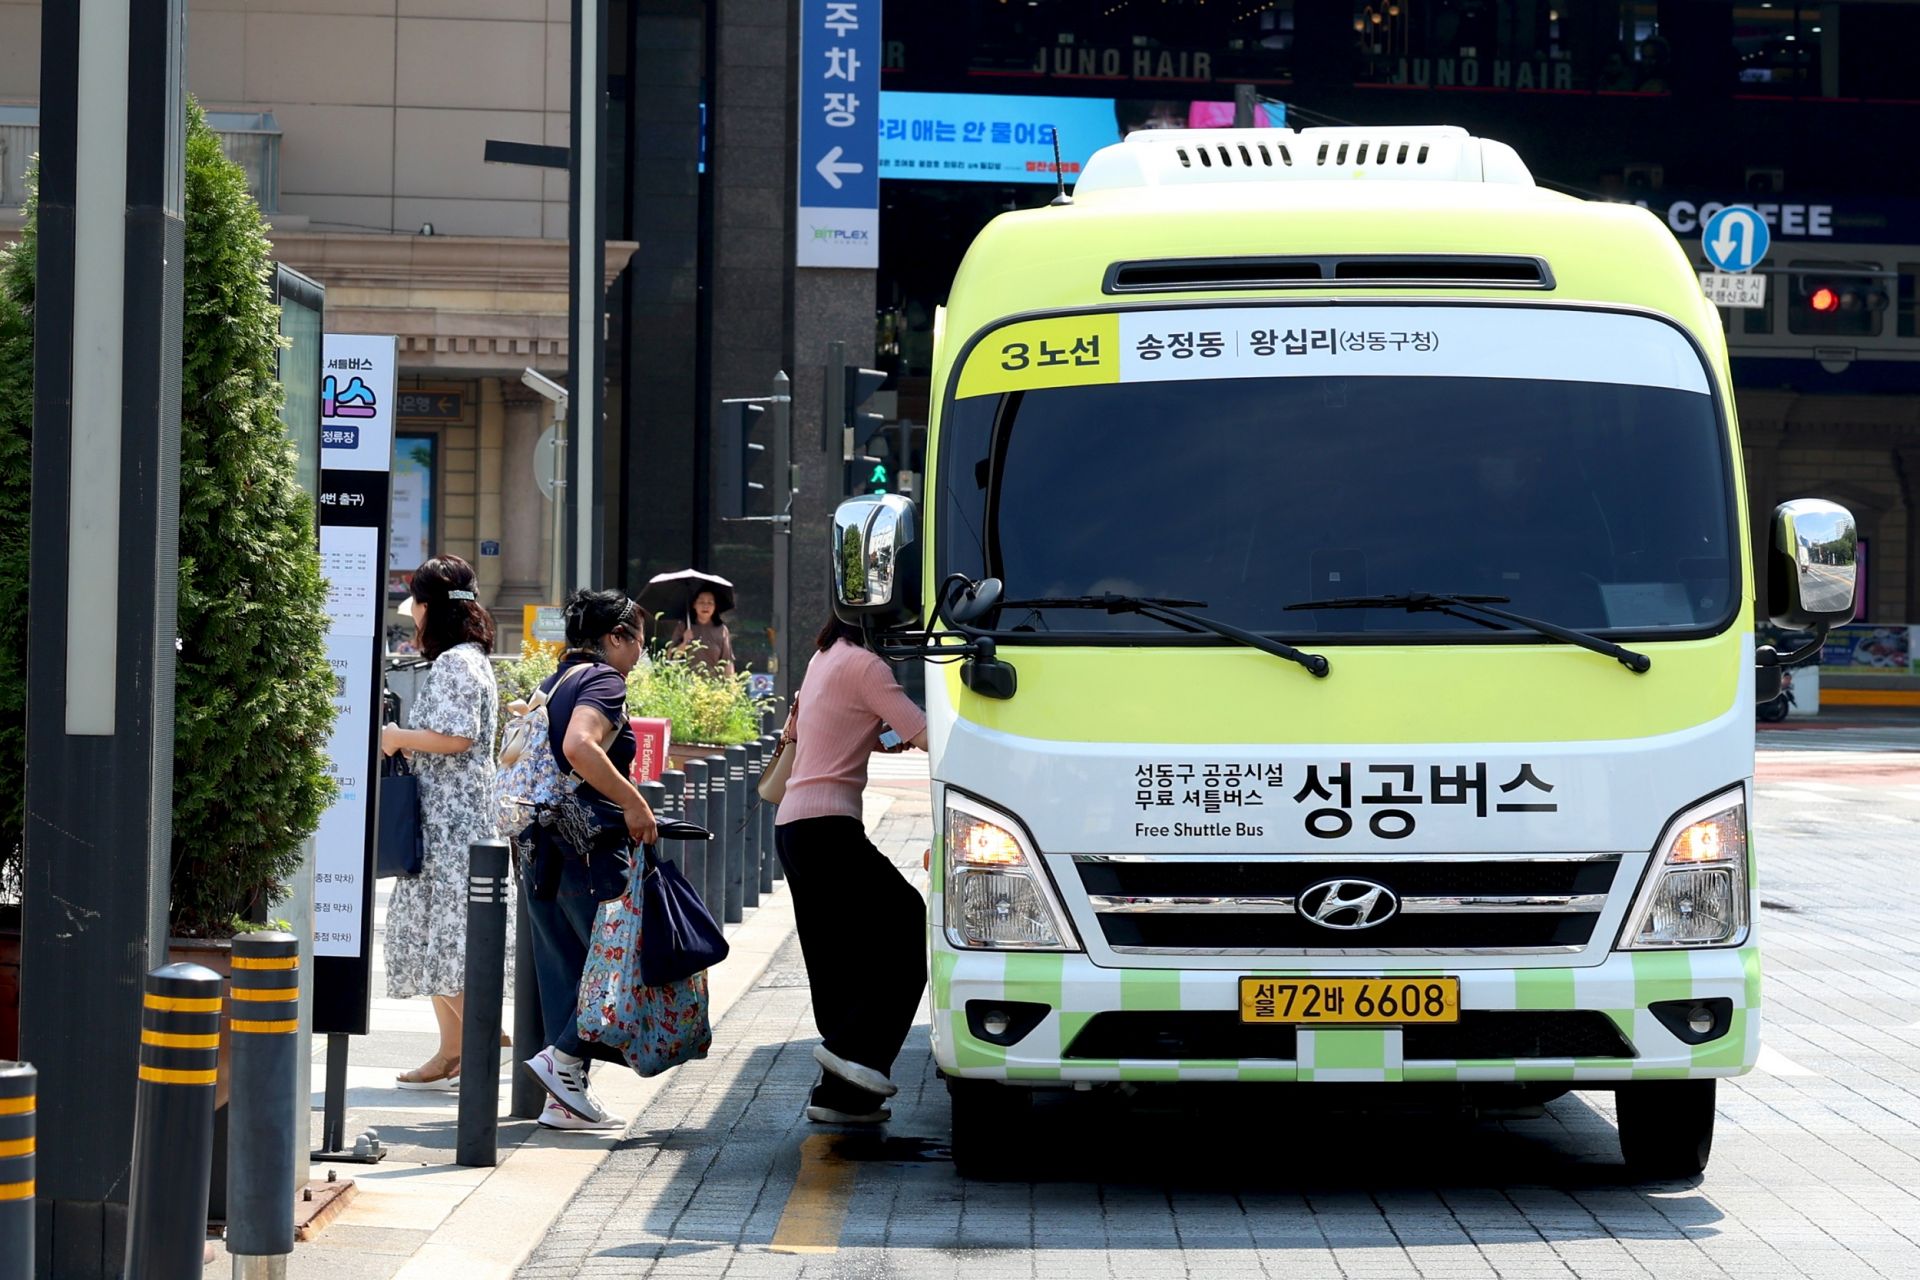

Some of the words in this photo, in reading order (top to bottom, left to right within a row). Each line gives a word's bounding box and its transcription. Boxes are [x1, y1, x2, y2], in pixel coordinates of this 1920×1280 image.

[824, 2, 862, 128] 주차장
[1033, 46, 1121, 77] JUNO
[1132, 50, 1212, 81] HAIR
[1392, 57, 1480, 87] JUNO
[1492, 59, 1574, 90] HAIR
[911, 119, 957, 143] 애는
[962, 121, 986, 143] 안
[990, 121, 1057, 146] 물어요
[814, 228, 869, 240] BITPLEX
[1136, 330, 1225, 361] 송정동
[327, 357, 373, 371] 셔틀버스
[322, 430, 355, 444] 정류장
[643, 734, 654, 748] Fire
[1134, 763, 1196, 789] 성동구
[1202, 763, 1284, 789] 공공시설
[1134, 789, 1176, 811] 무료
[1182, 789, 1264, 814] 셔틀버스
[1293, 761, 1558, 840] 성공버스
[1135, 821, 1170, 837] Free
[1173, 821, 1231, 837] Shuttle
[1235, 821, 1264, 837] Bus
[1354, 984, 1445, 1017] 6608
